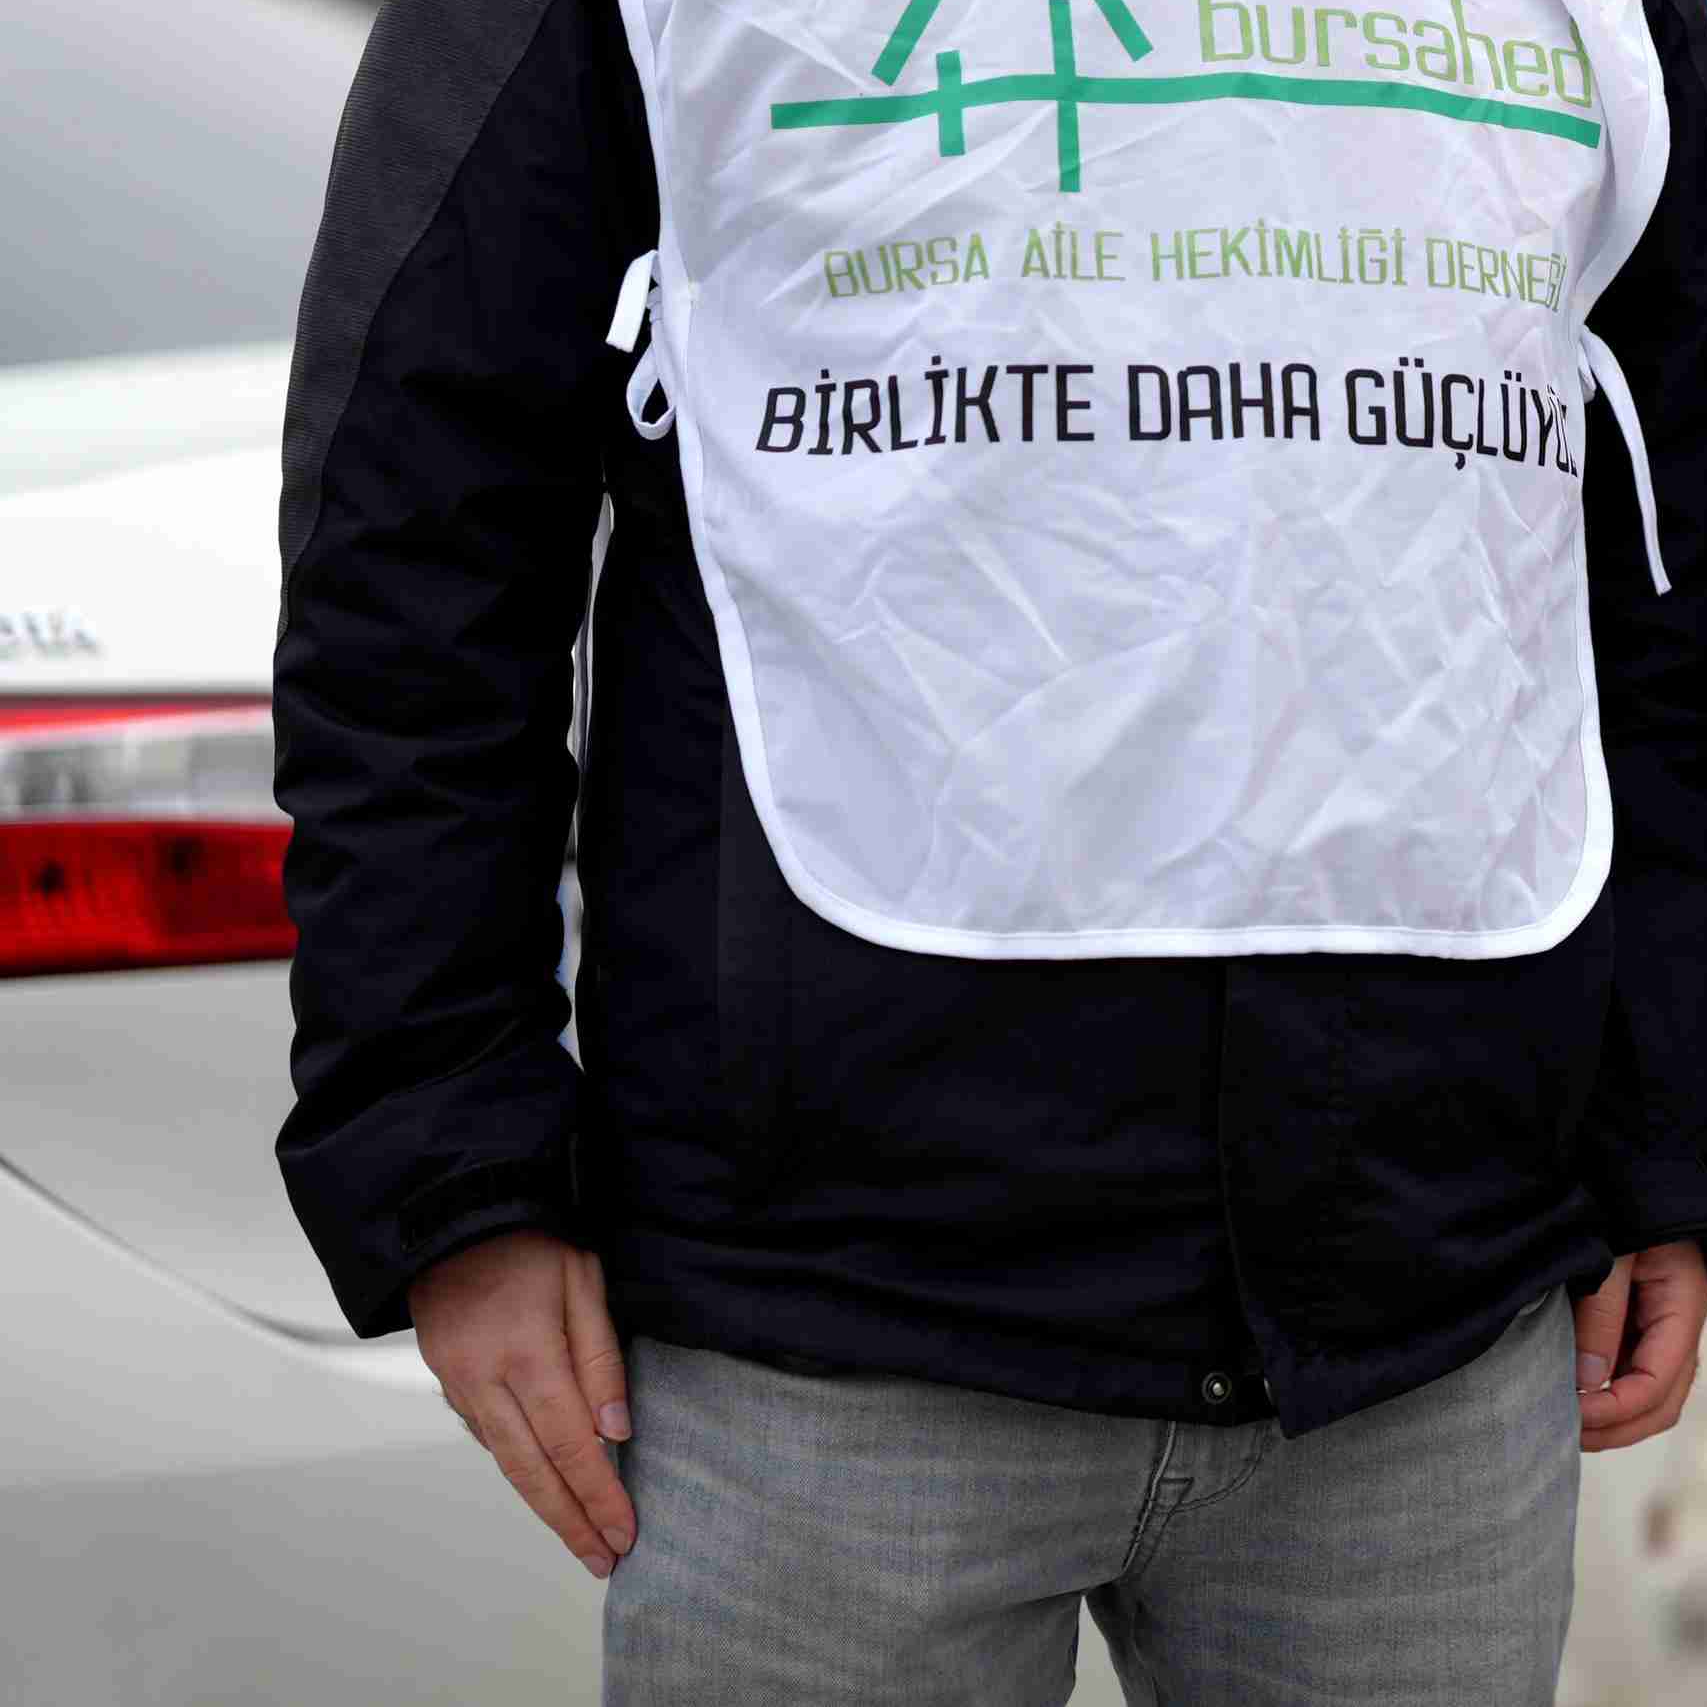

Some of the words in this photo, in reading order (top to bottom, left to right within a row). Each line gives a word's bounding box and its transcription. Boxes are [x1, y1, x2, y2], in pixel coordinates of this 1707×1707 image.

[825, 235, 990, 298] BURSA
[1020, 219, 1127, 283] AİLE
[1150, 216, 1408, 287] HEKİMLİĞİ
[1425, 237, 1568, 313] DERNEĞİ
[754, 354, 1096, 456] BİRLİKTE
[1126, 361, 1322, 443] DAHA
[1344, 355, 1579, 479] GÜÇLÜYÜ
